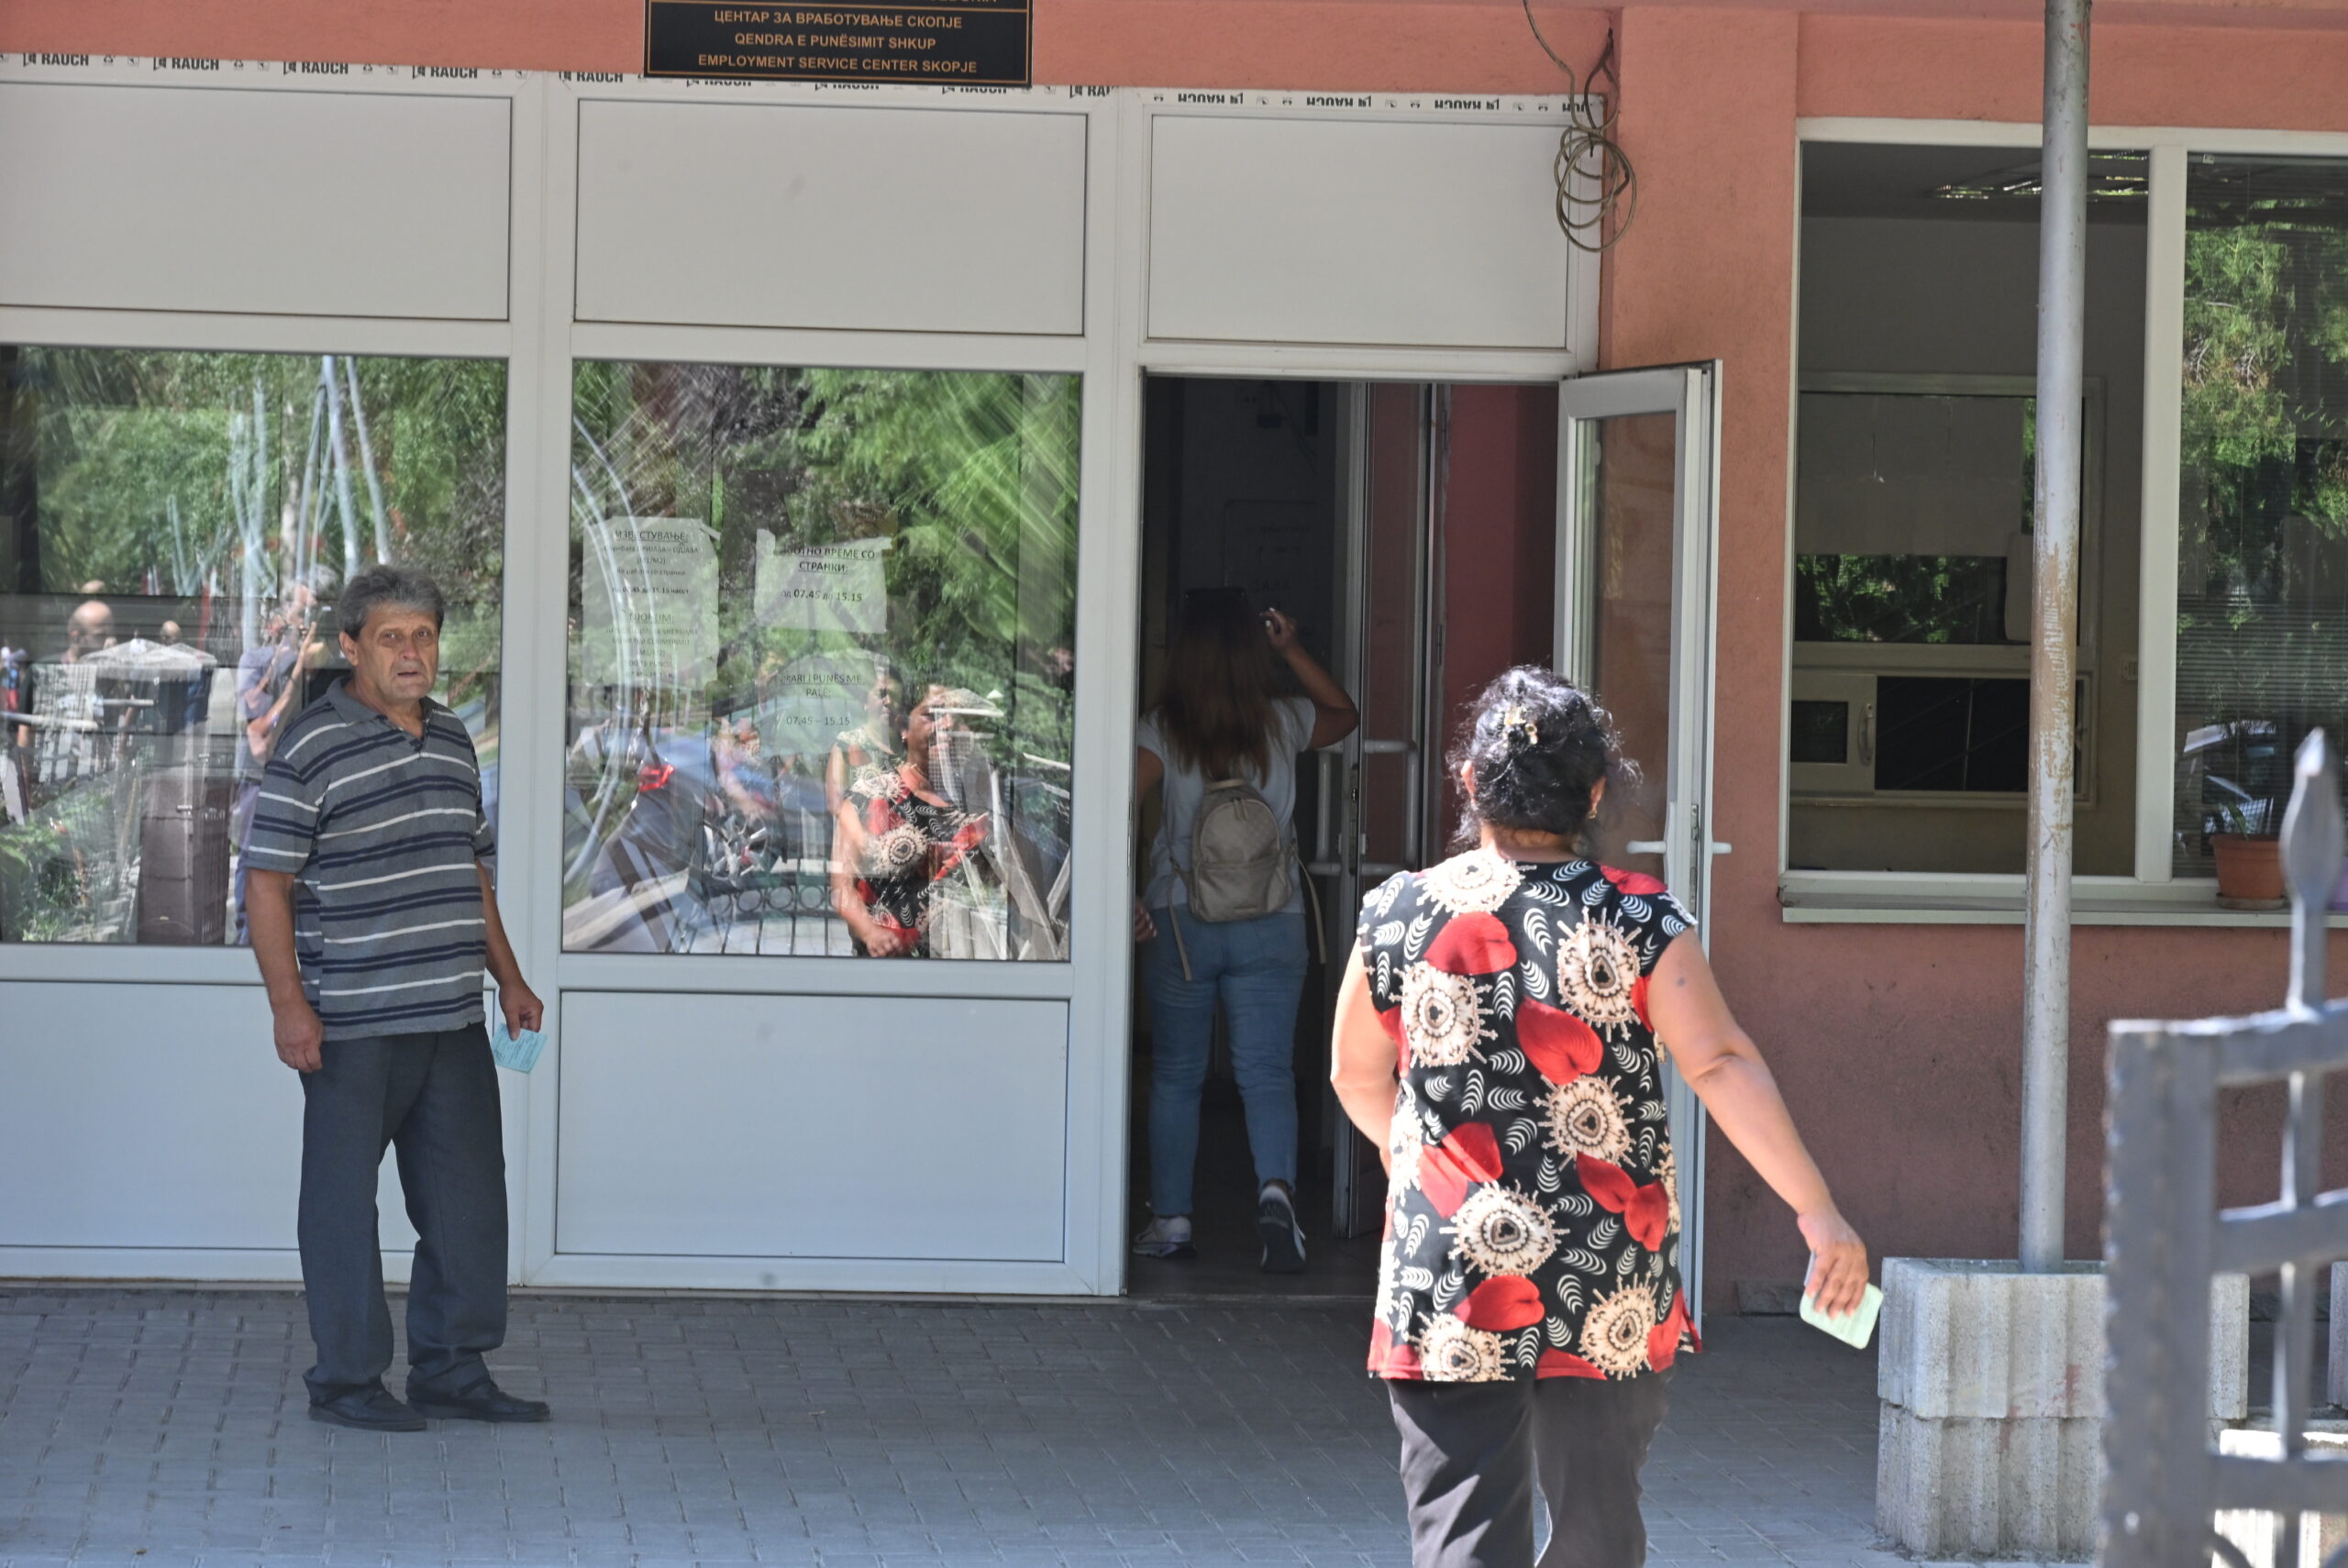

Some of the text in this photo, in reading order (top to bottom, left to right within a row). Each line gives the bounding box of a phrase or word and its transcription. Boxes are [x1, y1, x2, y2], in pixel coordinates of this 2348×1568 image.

[714, 10, 962, 28] ЦЕНТАР ЗА ВРАБОТУВАЊЕ СКОПЈЕ
[735, 33, 936, 50] QENDRA E PUNËSIMIT SHKUP
[41, 53, 89, 66] RAUCH
[172, 58, 219, 71] RAUCH
[698, 54, 977, 73] EMPLOYMENT SERVICE CENTER SKOPJE
[301, 62, 349, 74] RAUCH
[615, 530, 689, 542] ИЗВСТУВАЊЕ:
[825, 547, 859, 558] ВРЕМЕ
[861, 550, 875, 558] СО
[799, 561, 848, 573] СТРАНКИ:
[793, 589, 820, 599] 07.45
[836, 592, 862, 602] 15.15
